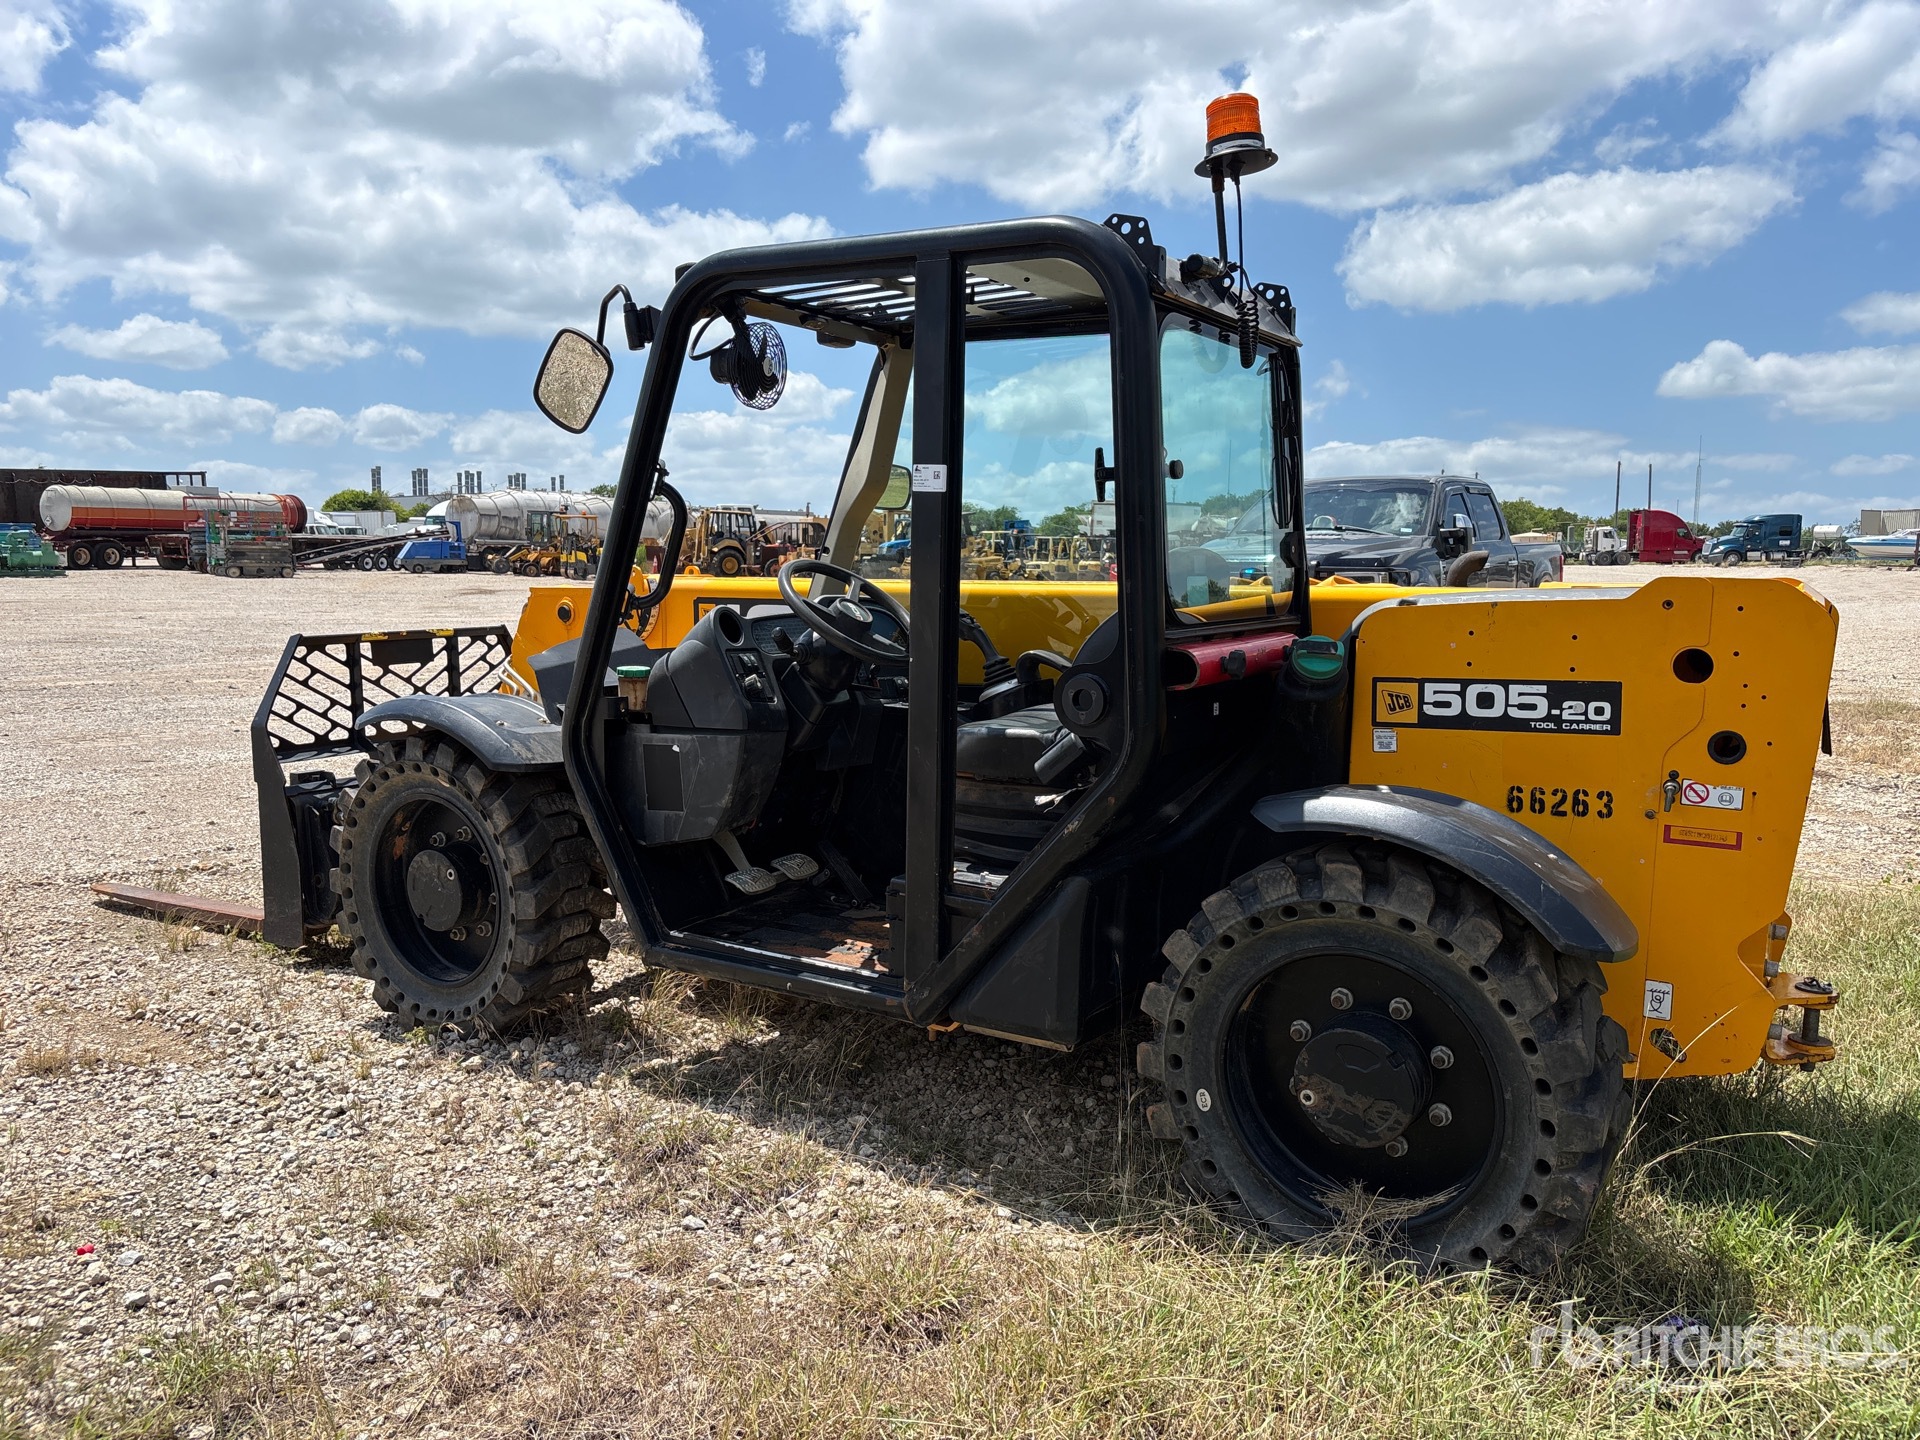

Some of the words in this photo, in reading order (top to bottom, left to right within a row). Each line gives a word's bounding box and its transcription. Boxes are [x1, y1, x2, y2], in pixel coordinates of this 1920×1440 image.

[1387, 692, 1412, 712] JCB
[1423, 683, 1611, 721] 505-20
[1530, 721, 1558, 730] TOOL
[1562, 722, 1611, 731] CARRIER
[1507, 785, 1614, 819] 66263
